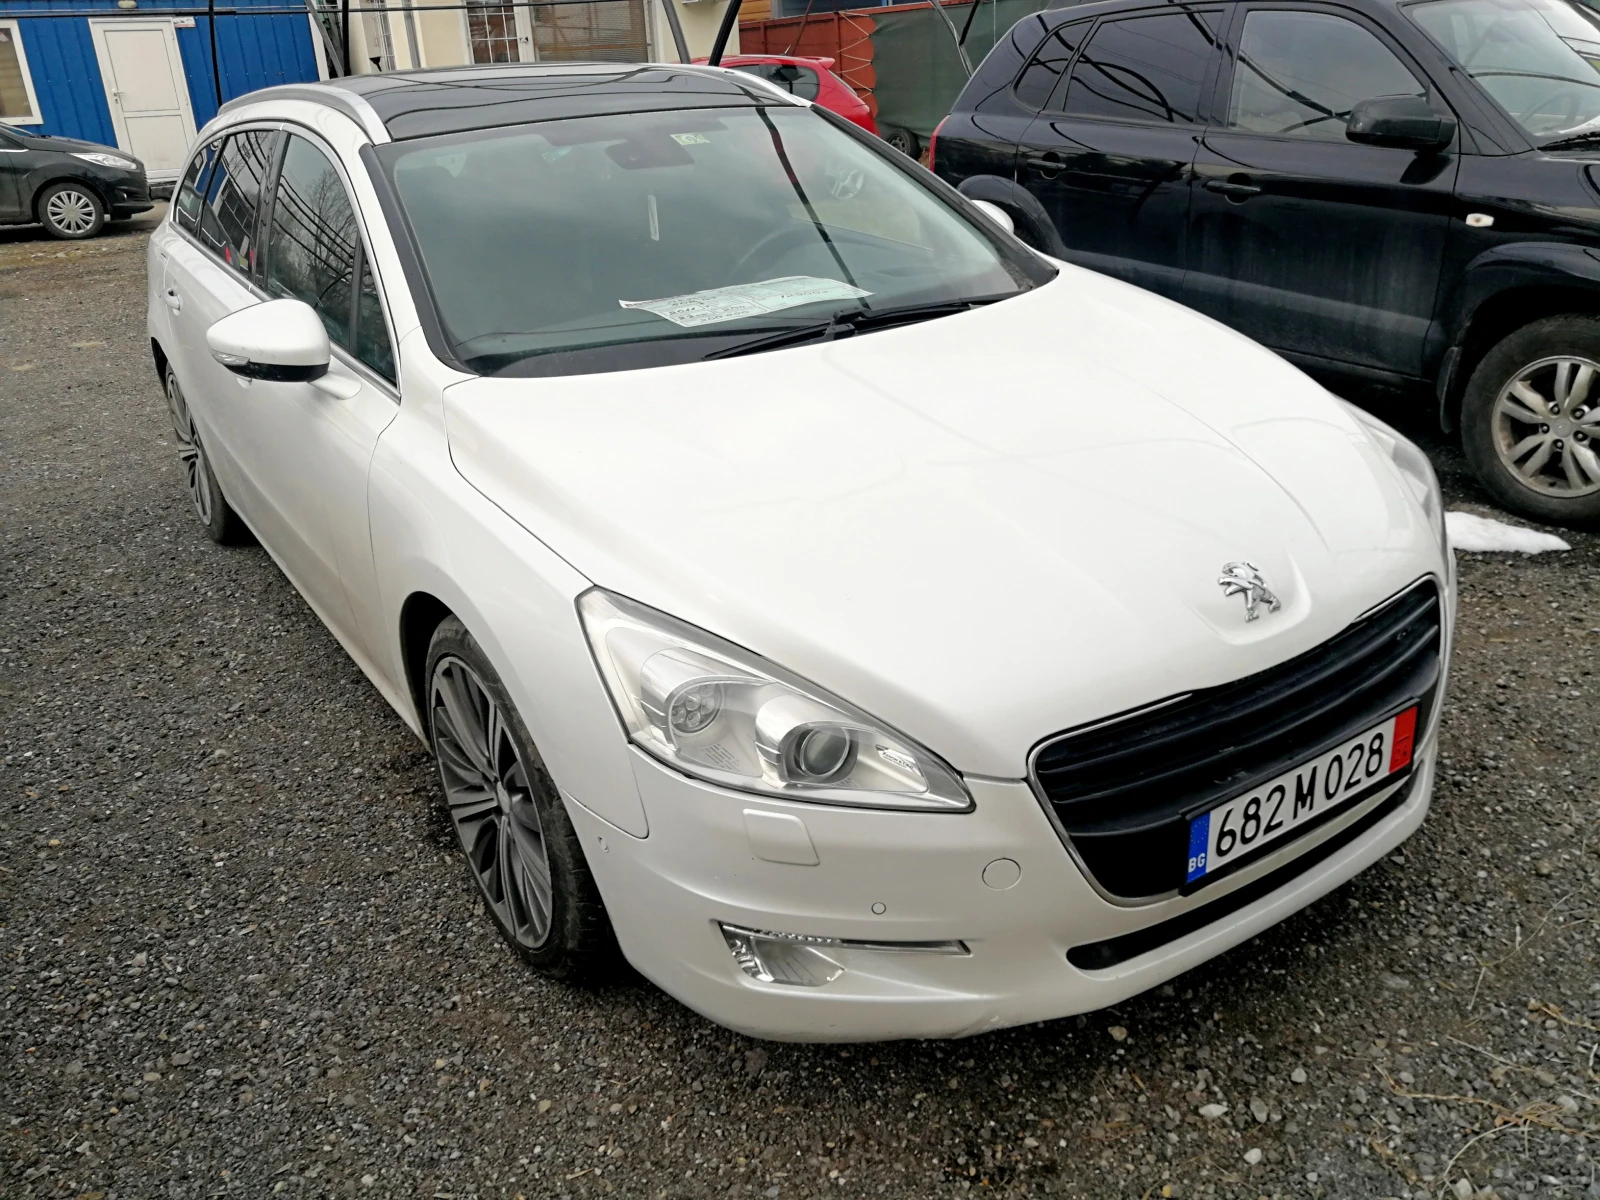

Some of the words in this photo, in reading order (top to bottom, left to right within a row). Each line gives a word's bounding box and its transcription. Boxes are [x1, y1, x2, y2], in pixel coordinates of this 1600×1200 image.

[1215, 783, 1286, 858] 682
[1324, 732, 1385, 801] 028
[1188, 852, 1206, 873] BG
